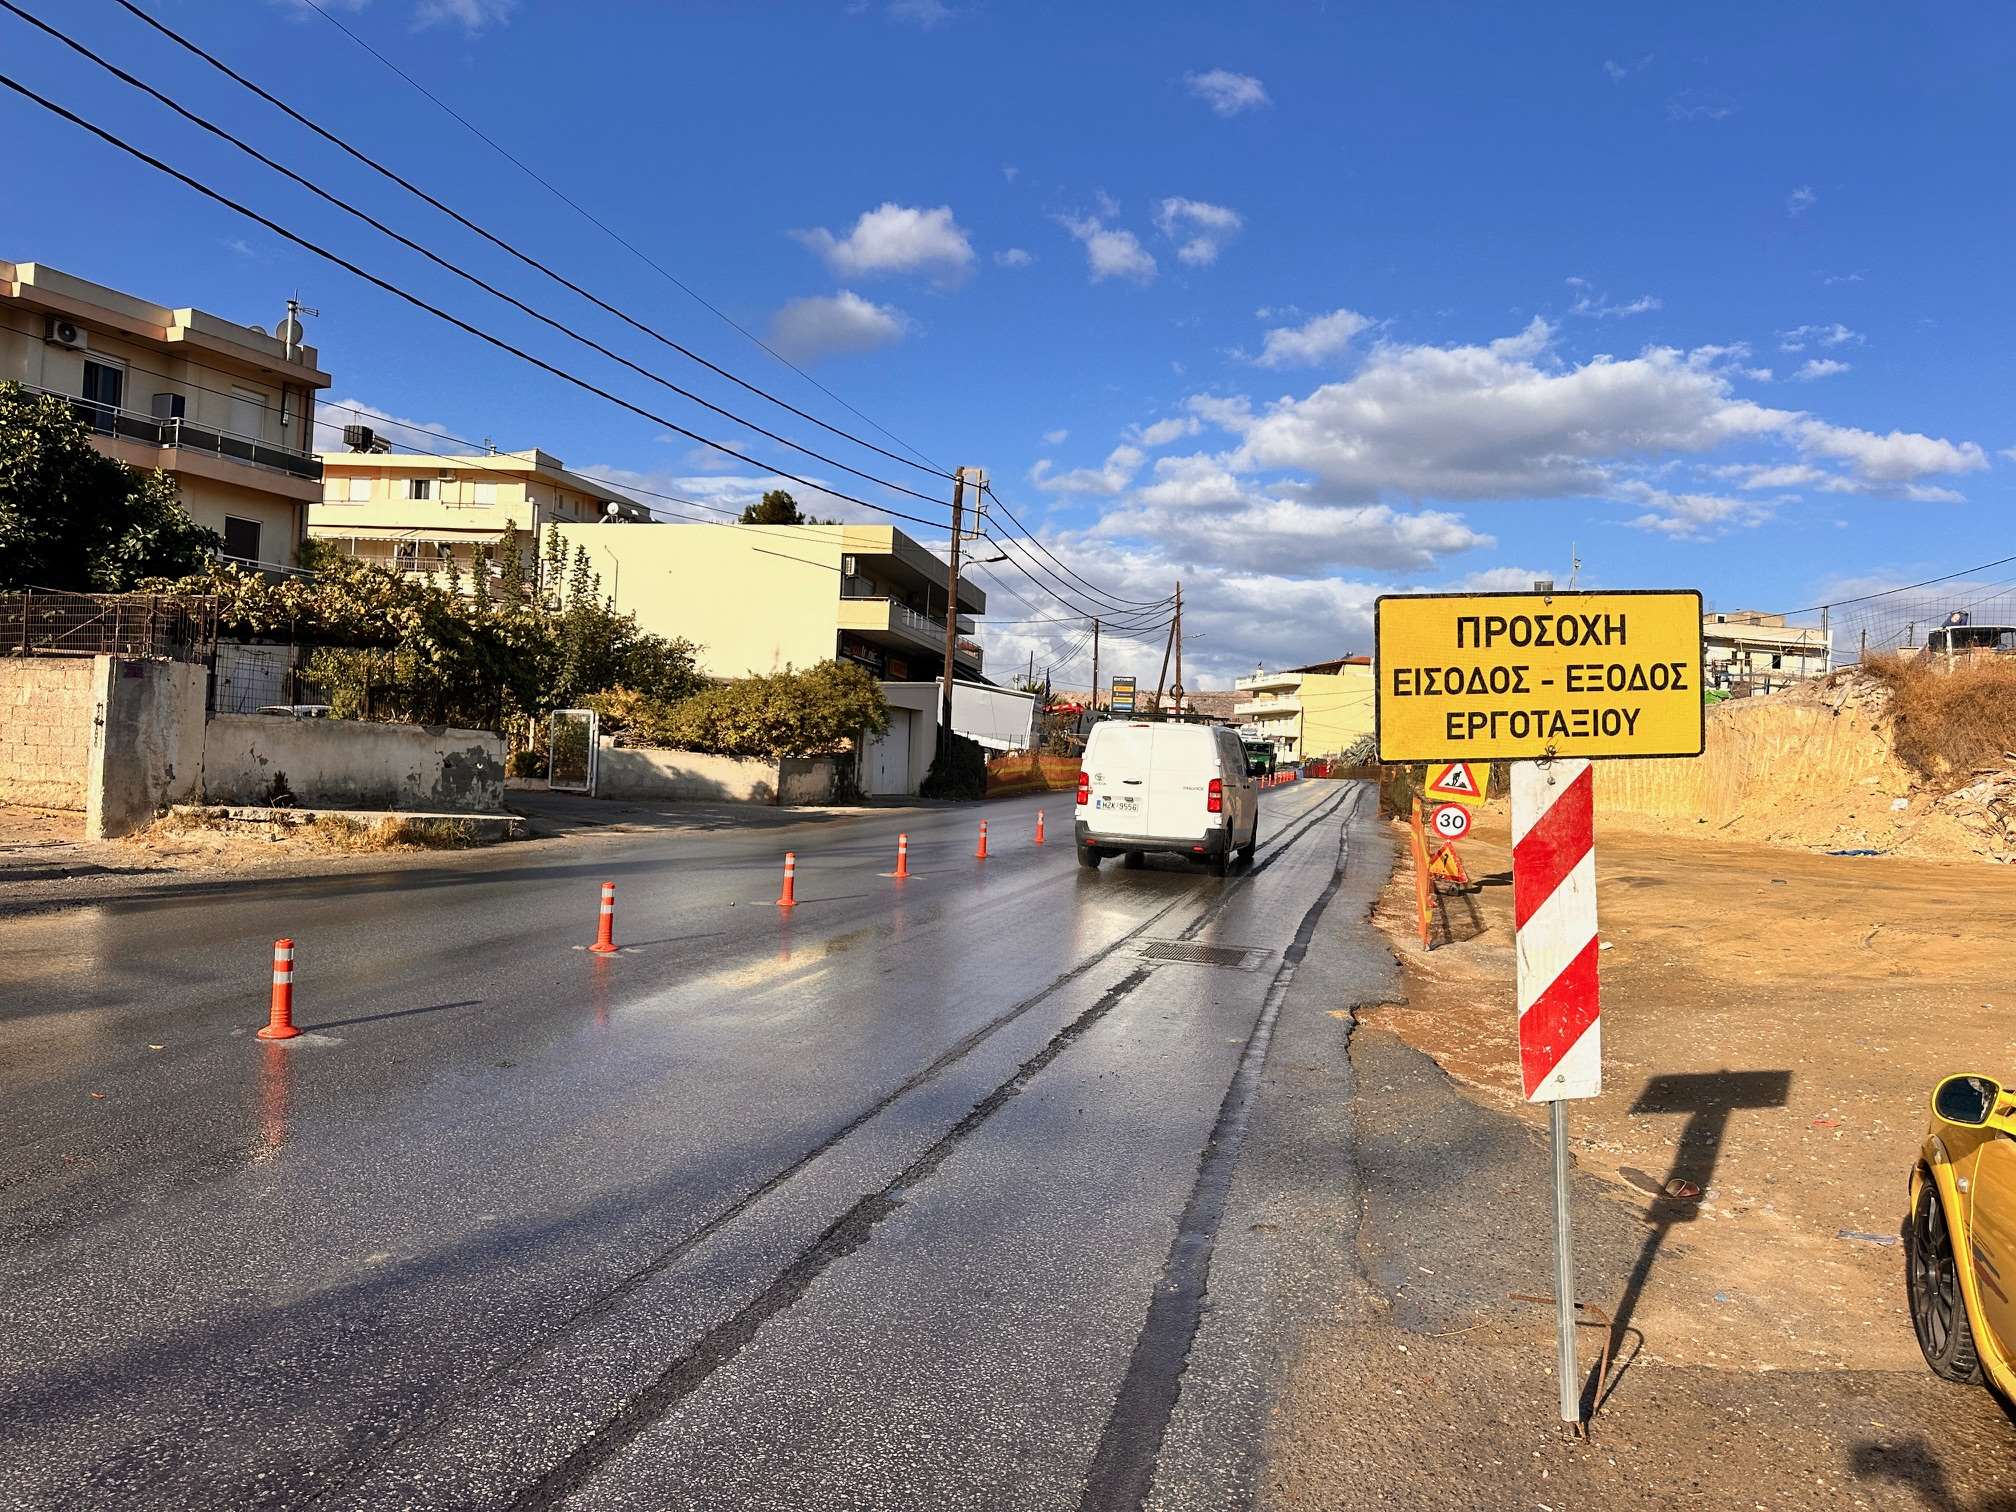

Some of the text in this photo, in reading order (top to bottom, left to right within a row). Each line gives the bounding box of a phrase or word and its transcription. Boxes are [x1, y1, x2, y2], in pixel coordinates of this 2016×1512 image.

[1457, 614, 1626, 648] ΠΡΟΣΟΧΗ
[1393, 665, 1530, 696] ΕΙΣΟΔΟΣ
[1566, 662, 1688, 693] ΕΞΟΔΟΣ
[1446, 708, 1641, 740] ΕΡΓΟΤΑΞΙΟΥ
[1440, 813, 1464, 830] 30
